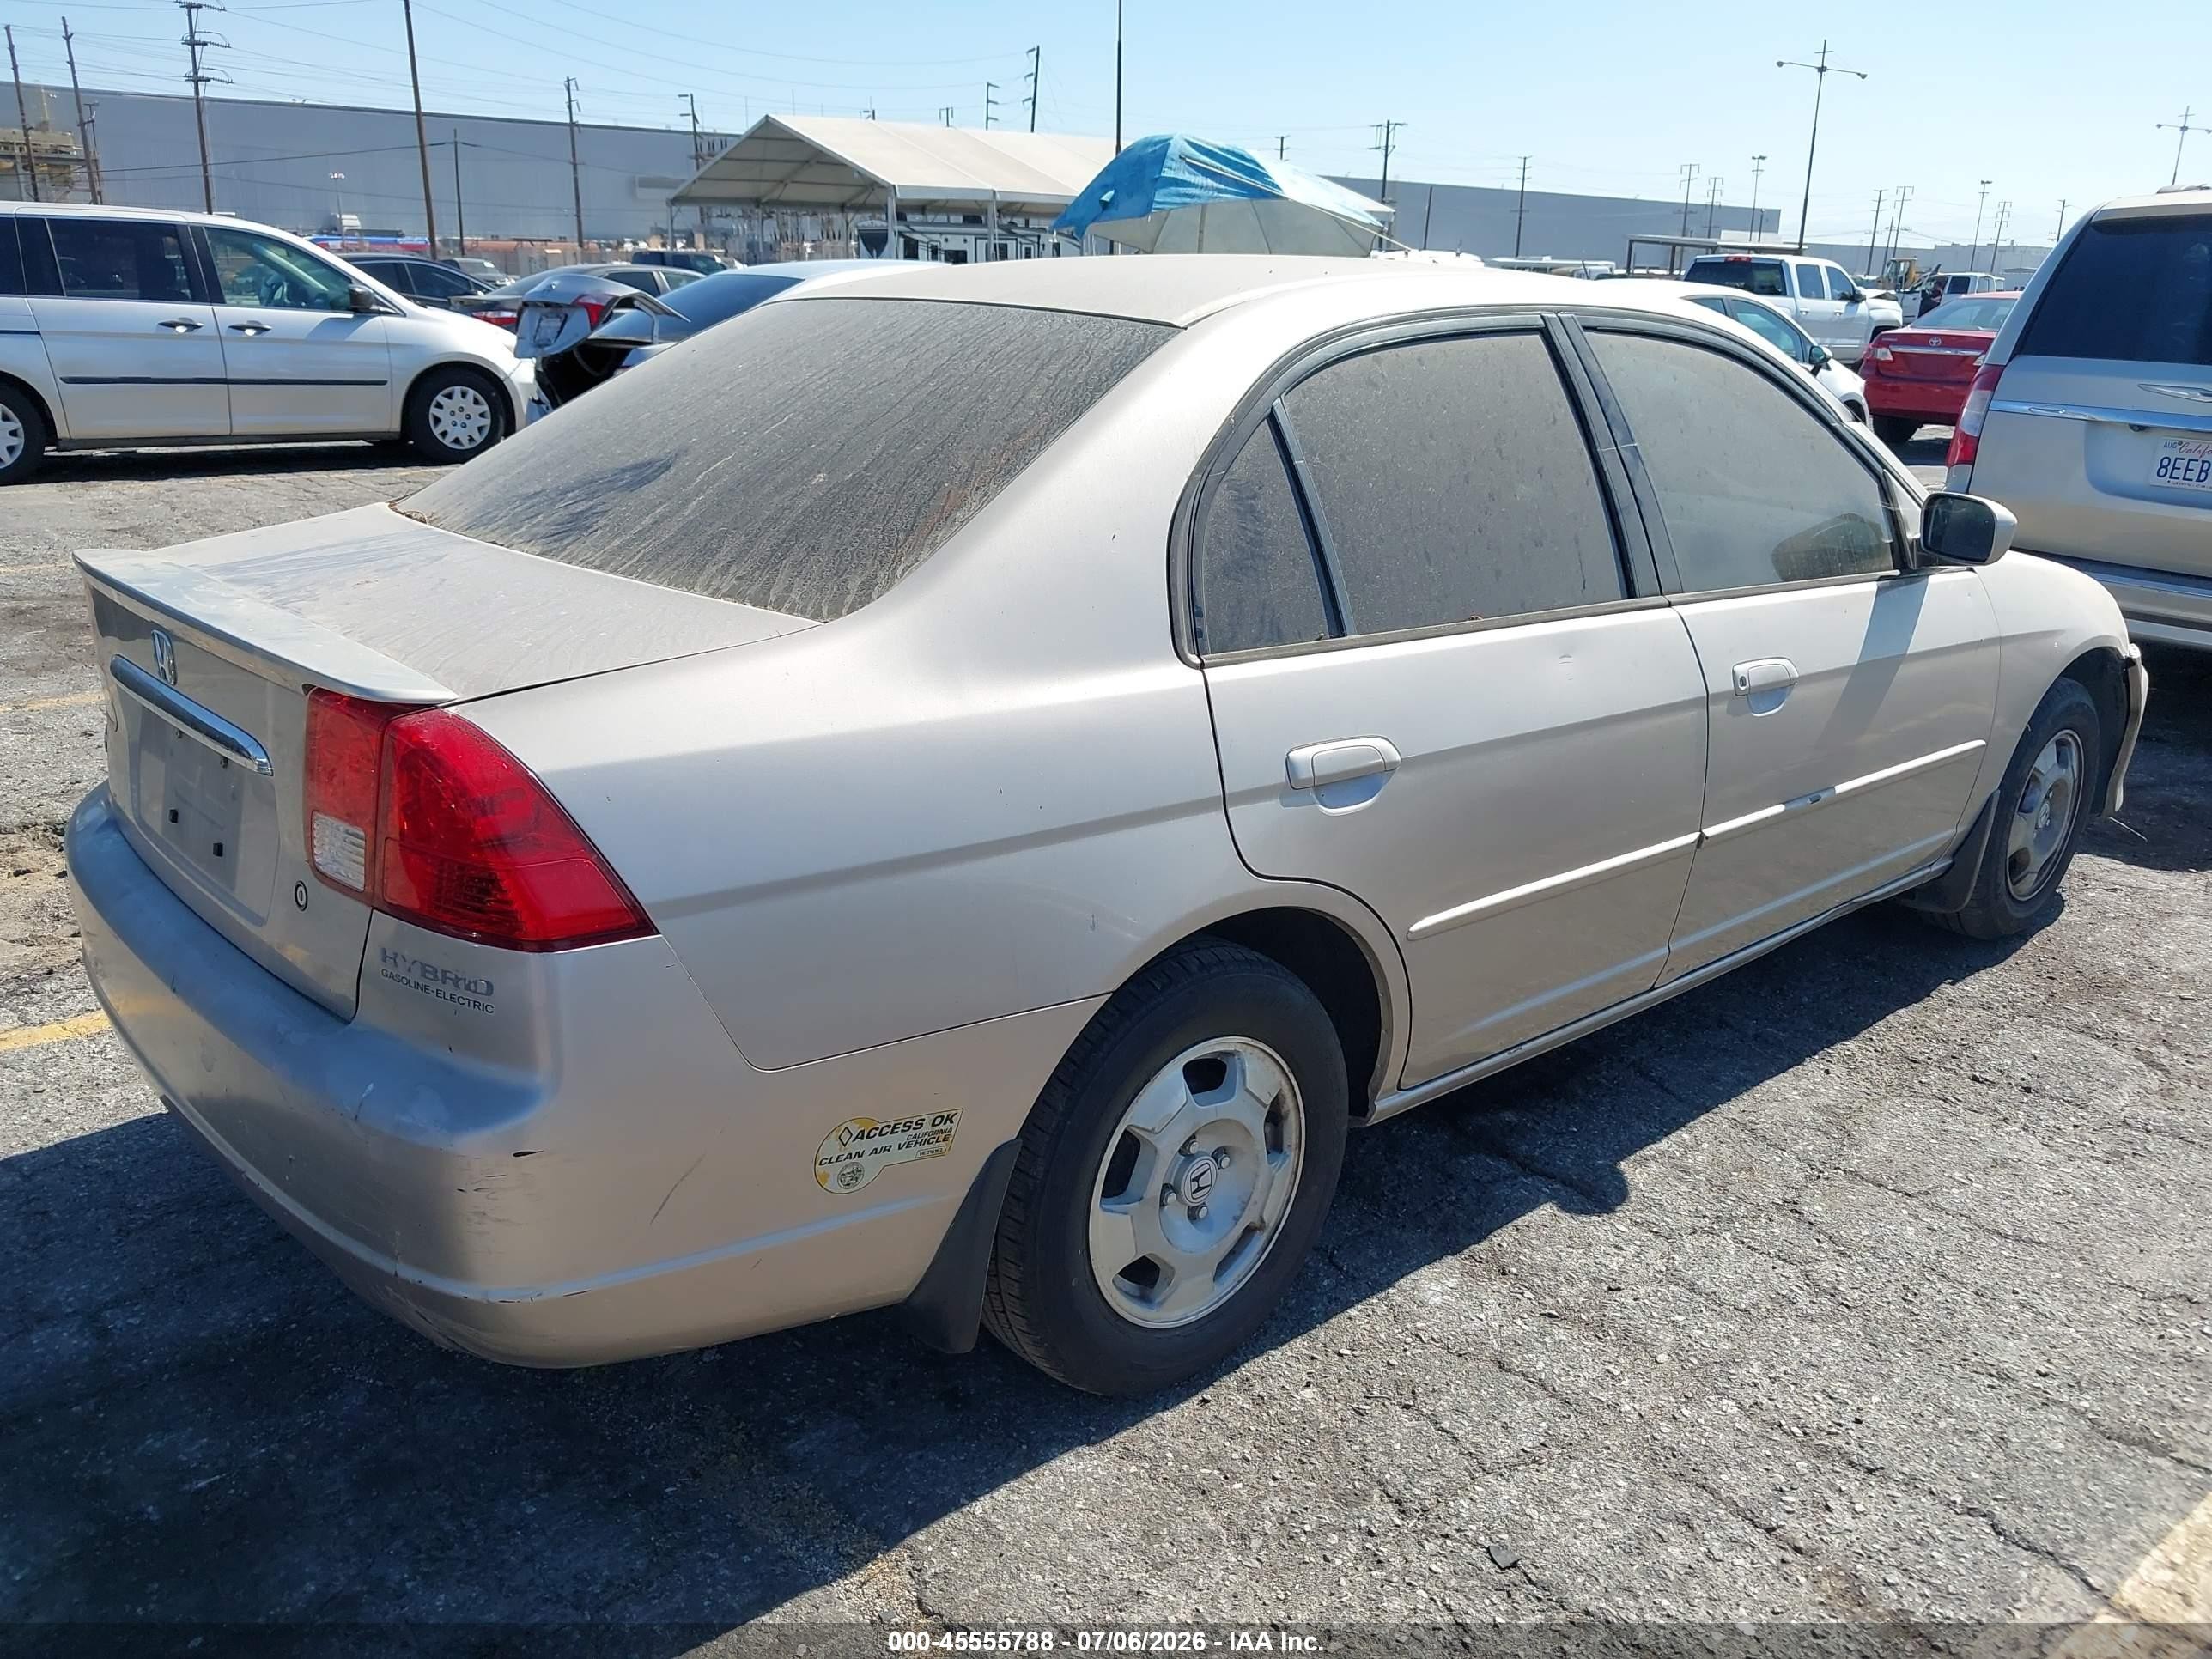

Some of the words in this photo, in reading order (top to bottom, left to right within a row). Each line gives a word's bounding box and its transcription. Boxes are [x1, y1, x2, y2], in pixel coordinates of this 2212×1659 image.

[2163, 441, 2178, 449] AUG
[2156, 456, 2212, 483] 8EEB
[381, 968, 495, 1014] GASOLINE-ELECTRIC
[852, 1118, 926, 1143] ACCESS
[931, 1112, 958, 1127] OK
[906, 1127, 953, 1141] CALIFORNIA
[817, 1149, 866, 1167] CLEAN
[868, 1144, 893, 1157] AIR
[897, 1133, 952, 1152] VEHICLE
